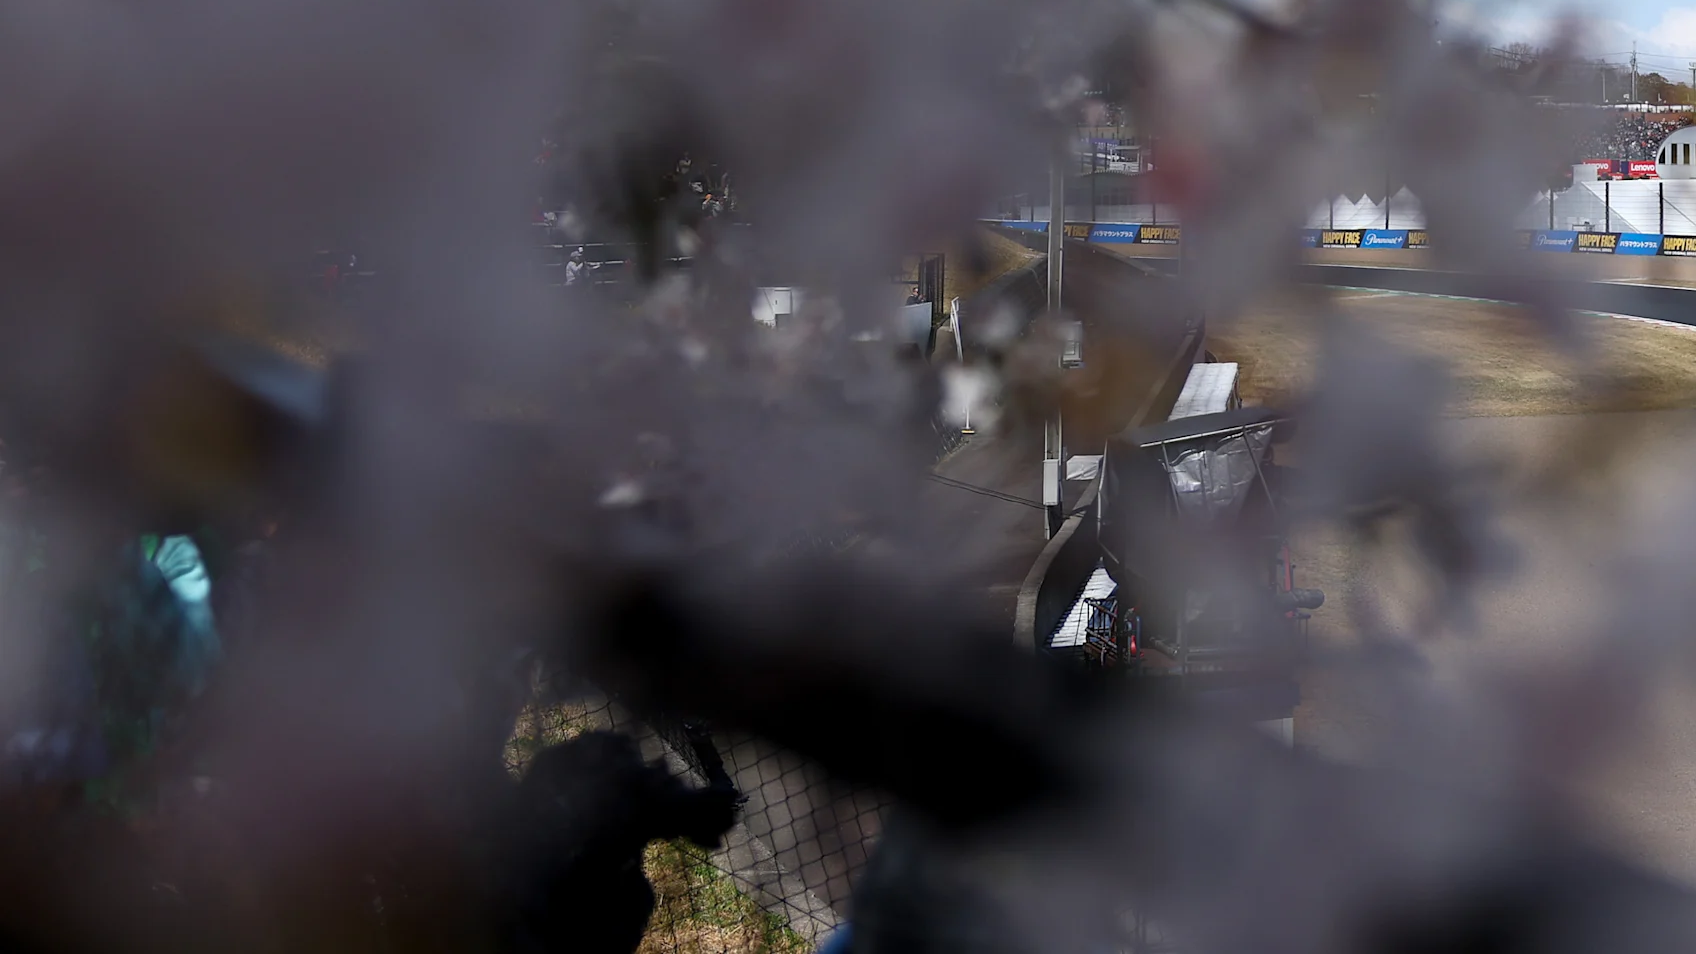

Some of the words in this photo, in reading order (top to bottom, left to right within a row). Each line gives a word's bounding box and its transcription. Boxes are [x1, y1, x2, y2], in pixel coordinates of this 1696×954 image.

[1631, 163, 1654, 171] Lenovo
[1141, 227, 1164, 239] HAPPY
[1164, 228, 1180, 239] FACE
[1323, 231, 1345, 244] HAPPY
[1345, 232, 1360, 244] FACE
[1365, 234, 1403, 245] Paramount+
[1536, 234, 1574, 245] Paramount+
[1578, 234, 1601, 247] HAPPY
[1601, 235, 1616, 248] FACE
[1663, 236, 1686, 250] HAPPY
